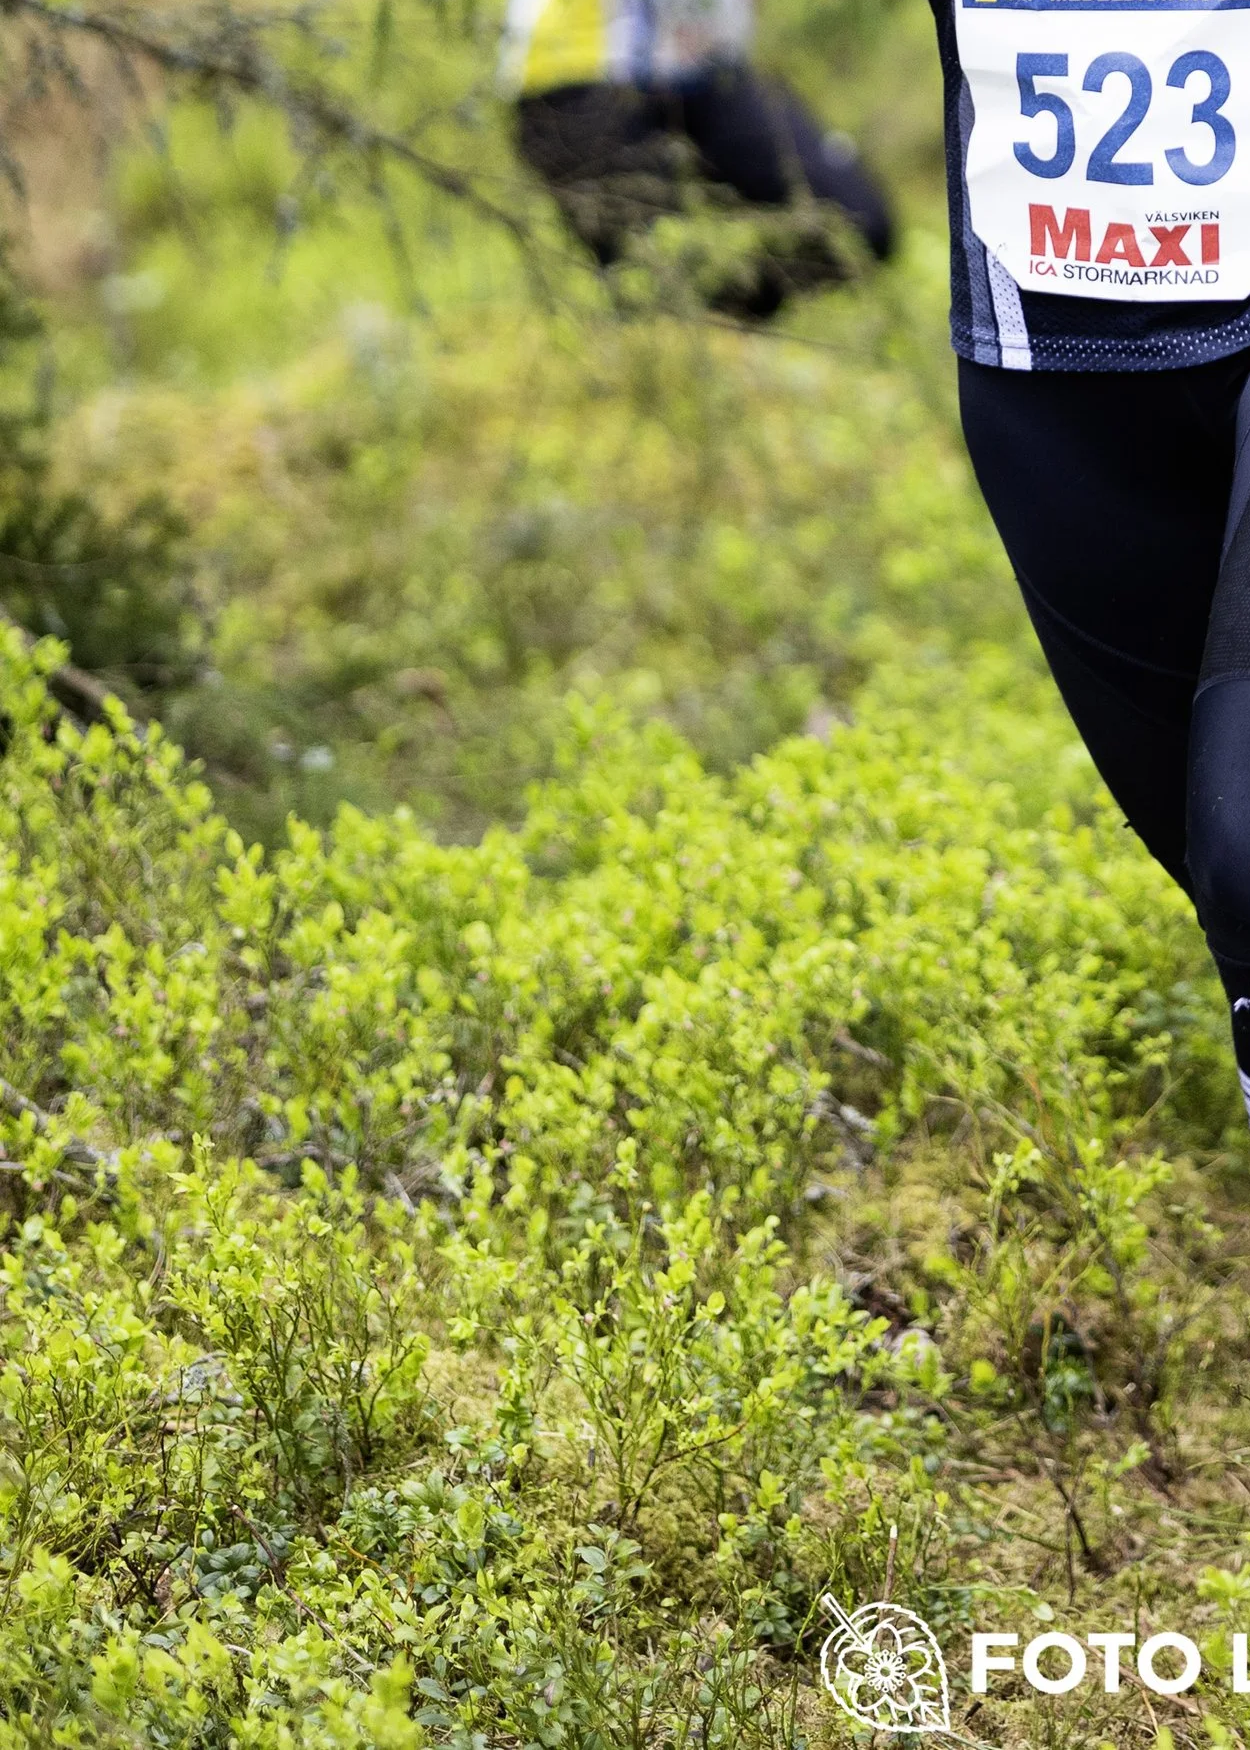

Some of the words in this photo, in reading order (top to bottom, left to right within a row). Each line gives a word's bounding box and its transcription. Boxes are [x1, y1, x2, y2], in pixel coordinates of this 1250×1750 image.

[1013, 50, 1237, 186] 523
[1145, 209, 1220, 222] VÄLSVIKEN
[1029, 261, 1058, 278] ICA
[1063, 263, 1220, 286] STORMARKNAD
